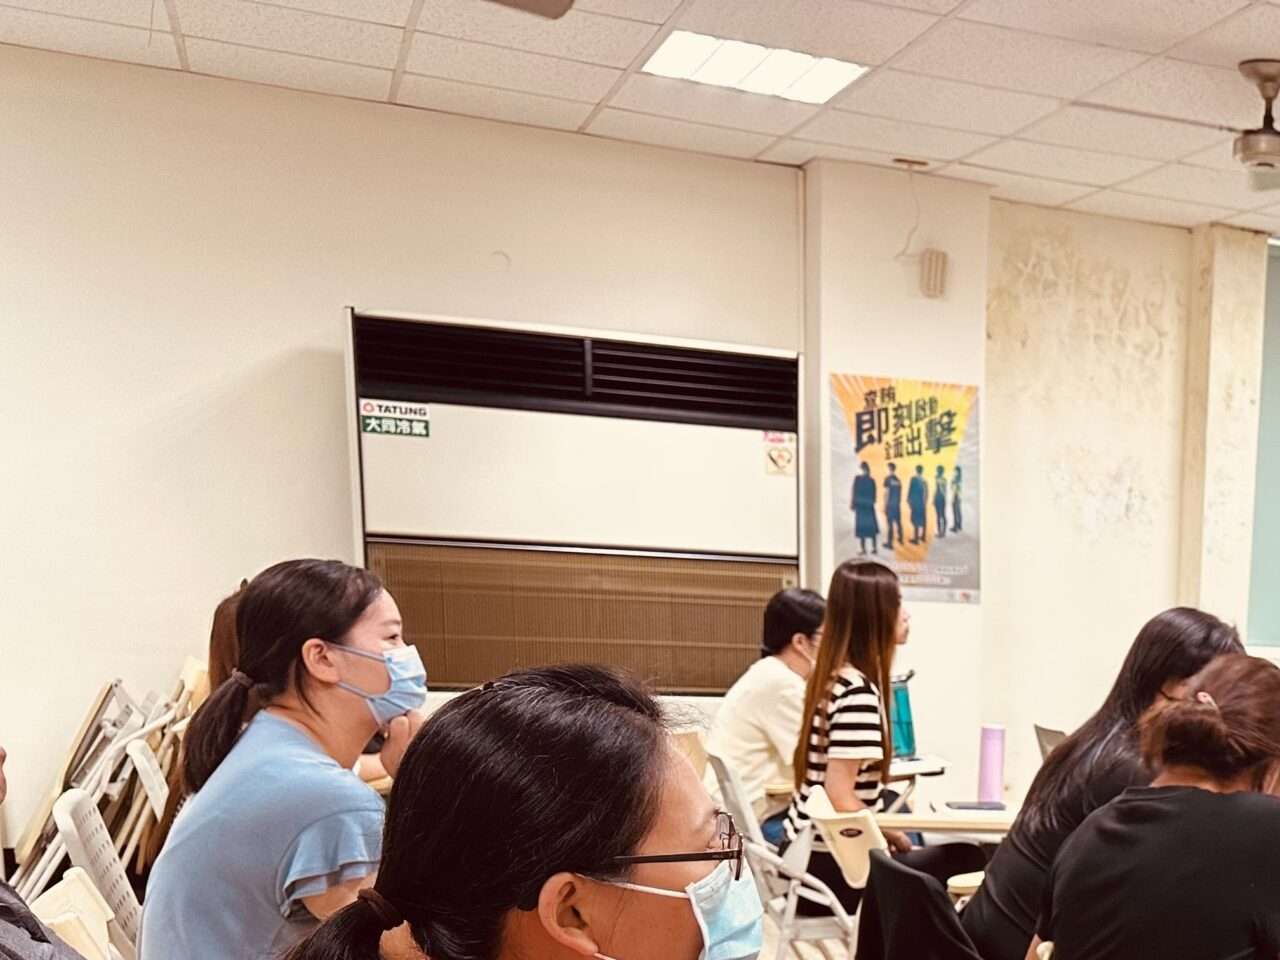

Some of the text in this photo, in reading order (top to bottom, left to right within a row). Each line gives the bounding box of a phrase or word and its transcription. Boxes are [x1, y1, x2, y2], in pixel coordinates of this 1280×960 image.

[377, 404, 427, 416] TATUNG
[364, 417, 427, 436] 大同冷氣
